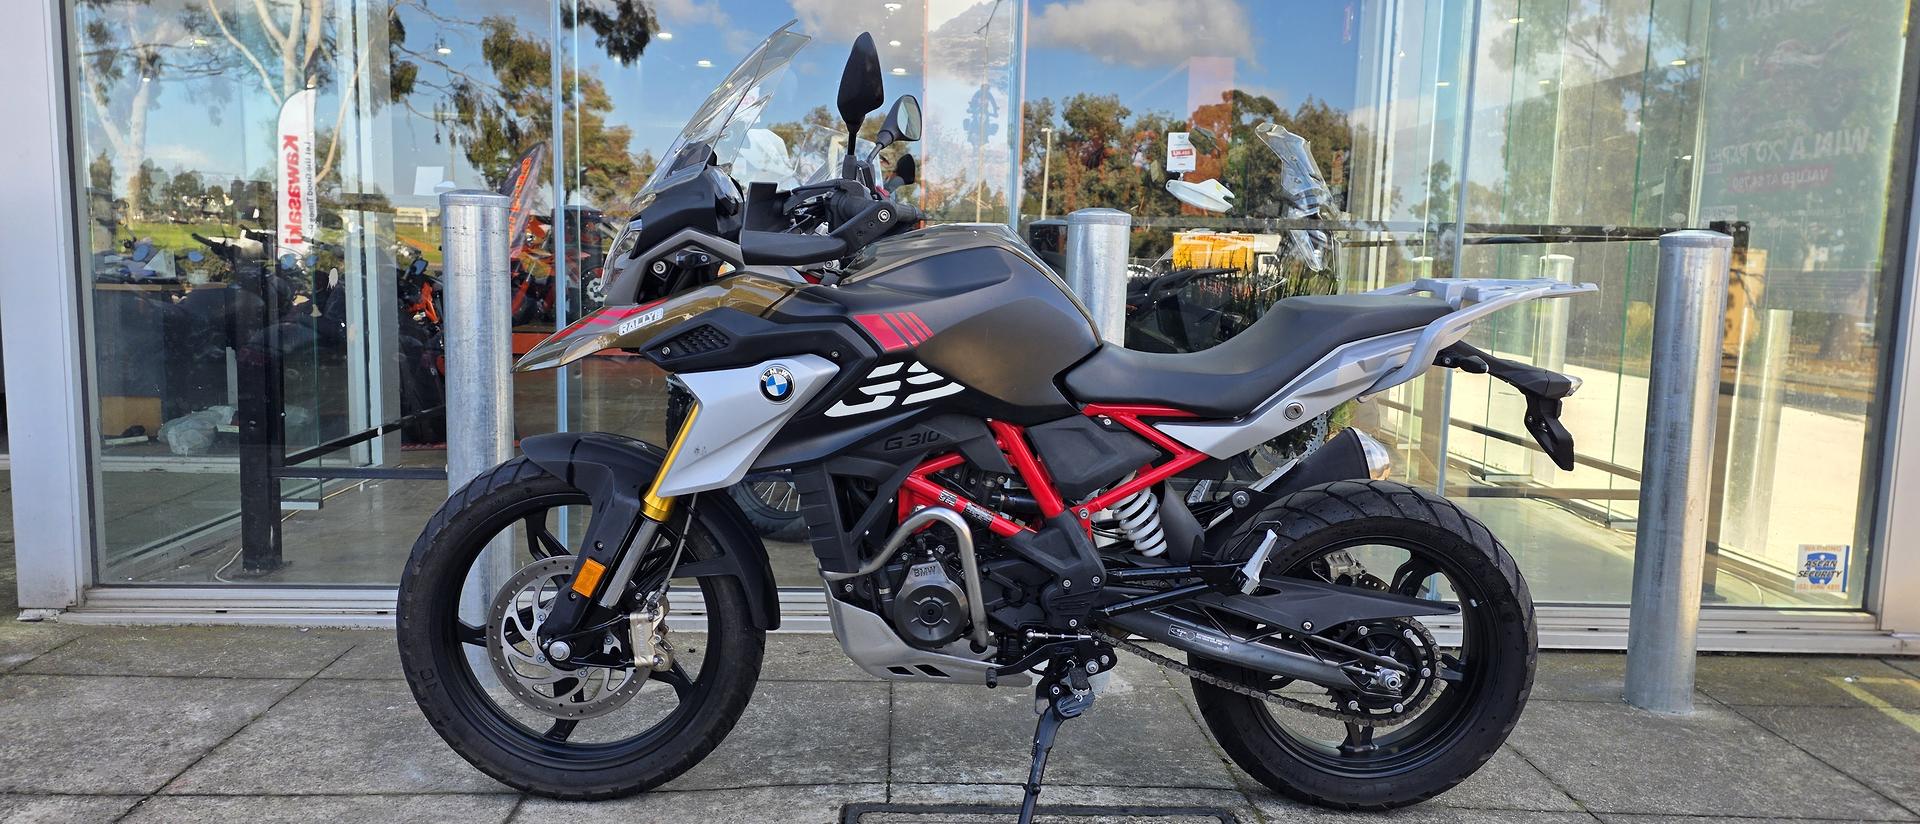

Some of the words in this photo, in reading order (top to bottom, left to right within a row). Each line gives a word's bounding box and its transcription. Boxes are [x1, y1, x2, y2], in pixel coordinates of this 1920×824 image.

[884, 436, 903, 450] G
[906, 431, 940, 447] 310
[914, 566, 936, 577] BMW
[1797, 570, 1842, 578] SECURITY
